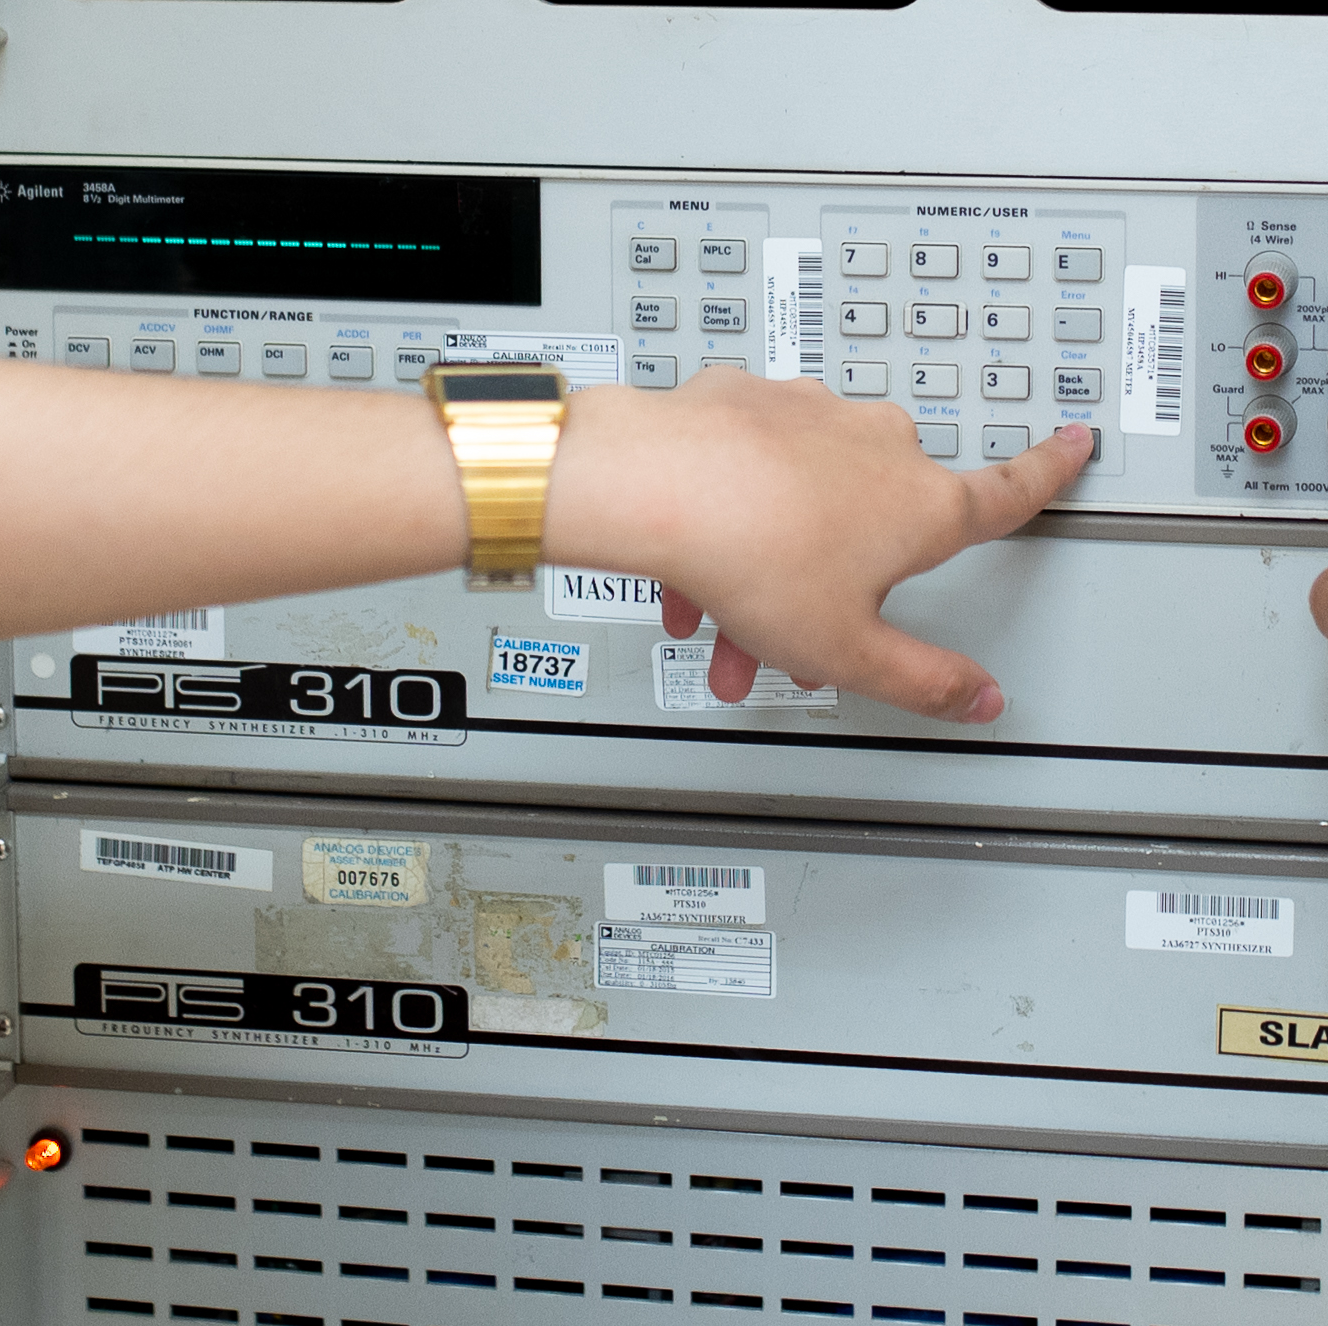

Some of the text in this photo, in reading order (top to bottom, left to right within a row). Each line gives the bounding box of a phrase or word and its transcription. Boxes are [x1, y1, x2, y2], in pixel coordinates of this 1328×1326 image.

[17, 184, 64, 200] Agilent
[83, 183, 115, 193] 3458A
[108, 194, 130, 205] Digit
[669, 200, 710, 211] MENU
[916, 206, 1029, 218] NUMERIC/USER
[1261, 221, 1297, 232] Sense
[1061, 231, 1091, 240] Menu
[1266, 235, 1293, 245] Wire)
[635, 244, 660, 254] Auto
[703, 246, 732, 255] NPLC
[635, 254, 652, 264] Cal
[845, 249, 856, 263] 7
[916, 252, 926, 266] 8
[988, 253, 998, 267] 9
[1059, 255, 1069, 269] E
[1215, 271, 1227, 281] HI
[1061, 290, 1086, 300] Error
[635, 303, 660, 313] Auto
[703, 305, 731, 315] Offset
[194, 308, 314, 322] FUNCTION/RANGE
[635, 314, 658, 323] Zero
[845, 309, 856, 323] 4
[916, 311, 926, 325] 5
[987, 313, 998, 327] 6
[1303, 314, 1326, 323] MAX
[703, 316, 730, 327] Comp
[5, 326, 38, 337] Power
[139, 323, 176, 333] ACDCV
[402, 331, 422, 341] PER
[21, 340, 36, 349] On
[68, 343, 90, 353] DCV
[134, 345, 156, 355] ACV
[581, 344, 616, 352] C10115
[1211, 343, 1226, 352] LO
[200, 347, 224, 357] OHM
[265, 349, 284, 359] DCI
[332, 351, 350, 362] ACI
[493, 351, 564, 362] CALIBRATION
[1061, 350, 1087, 360] Clear
[398, 354, 426, 365] FREQ
[635, 362, 655, 372] Trig
[846, 369, 853, 382] 1
[916, 371, 926, 385] 2
[987, 373, 998, 387] 3
[1058, 375, 1083, 384] Back
[1058, 386, 1090, 397] Space
[1213, 384, 1244, 394] Guard
[1302, 386, 1325, 395] MAX
[941, 406, 960, 417] Key
[1061, 410, 1092, 420] Recall
[1216, 453, 1239, 463] MAX
[1244, 481, 1259, 491] All
[1263, 481, 1290, 492] Term
[563, 575, 663, 604] MASTER
[493, 638, 580, 655] CALIBRATION
[499, 651, 576, 678] 18737
[491, 672, 583, 692] SSET NUMBER
[97, 662, 442, 722] PTS 310
[99, 716, 439, 742] FREQUENCY SYNTHESIZER MHz
[313, 842, 364, 855] ANALOG
[338, 870, 400, 887] 007676
[329, 888, 409, 901] CALIBRATION
[673, 899, 706, 909] PTS310
[679, 914, 746, 924] SYNTHESIZER
[1197, 927, 1231, 937] PTS310
[651, 943, 715, 955] CALIBRATION
[1202, 941, 1272, 955] SYNTHESIZER
[100, 971, 444, 1034] PTS 310
[102, 1023, 442, 1054] FREQUENCY SYNTHESIZER MHz
